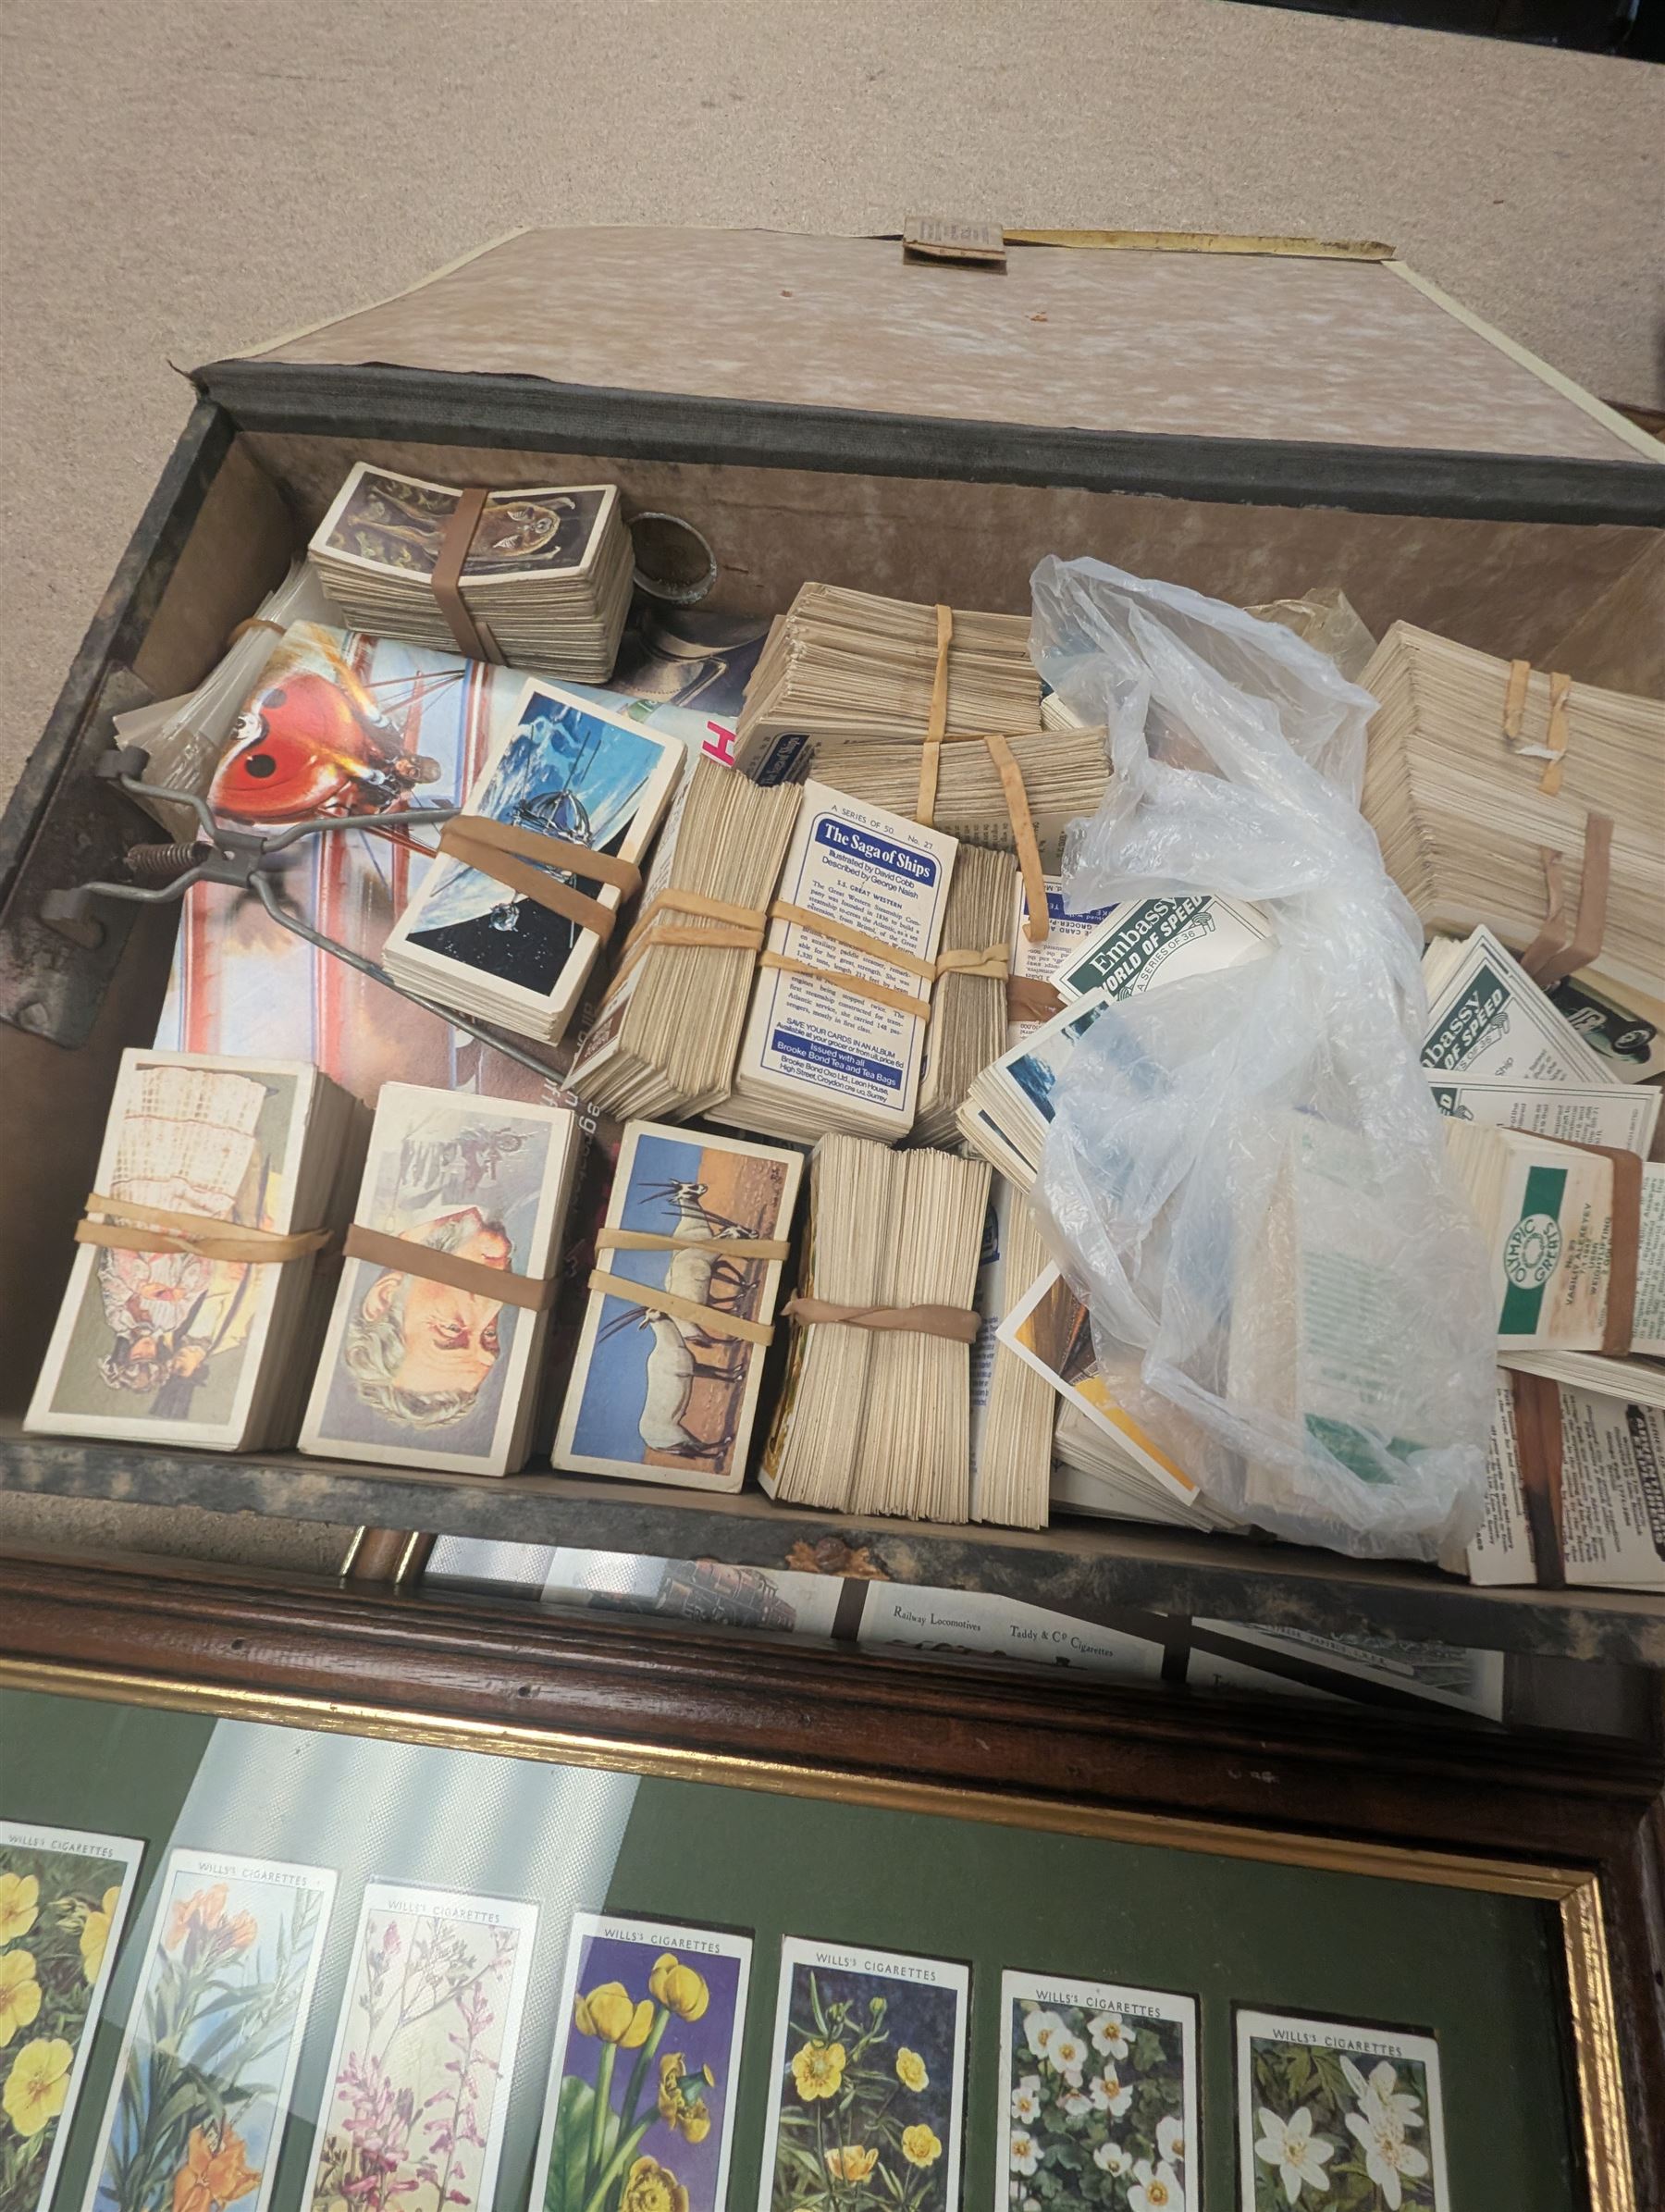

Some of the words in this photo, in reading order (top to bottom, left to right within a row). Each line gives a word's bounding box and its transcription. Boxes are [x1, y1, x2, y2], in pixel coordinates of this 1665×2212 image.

[842, 807, 867, 824] SERIES
[870, 819, 882, 829] OF
[884, 825, 894, 834] 50
[907, 834, 921, 845] No.
[924, 841, 933, 850] 27
[823, 822, 850, 846] The
[849, 833, 882, 862] Saga
[882, 846, 897, 865] of
[895, 851, 931, 881] Ships
[828, 848, 862, 868] Illustrated
[863, 862, 873, 873] by
[874, 867, 894, 881] David
[894, 875, 914, 889] Cobb
[821, 856, 860, 877] Described
[861, 871, 870, 882] by
[870, 875, 897, 893] George
[897, 886, 918, 899] Naish
[849, 884, 870, 896] GREAT
[872, 893, 902, 909] WESTERN
[812, 880, 824, 889] The
[828, 885, 844, 896] Great
[847, 894, 871, 907] Western
[873, 904, 902, 921] Steamship
[841, 899, 864, 912] founded
[1088, 896, 1178, 977] Embassy
[1141, 935, 1160, 956] OF
[1160, 896, 1203, 938] SPEED
[1141, 947, 1168, 981] SERIES
[1167, 935, 1181, 950] OF
[1182, 930, 1195, 941] 36
[786, 1017, 805, 1028] SAVE
[805, 1023, 826, 1035] YOUR
[826, 1030, 851, 1044] CARDS
[860, 1041, 871, 1050] AN
[871, 1044, 894, 1058] ALBUM
[1422, 990, 1483, 1069] bassy
[1444, 1045, 1462, 1070] OF
[1464, 988, 1503, 1047] SPEED
[776, 1041, 807, 1057] Brooke
[808, 1051, 829, 1064] Bond
[830, 1058, 845, 1069] Tea
[845, 1063, 860, 1074] and
[861, 1068, 875, 1079] Tea
[876, 1072, 895, 1087] Bags
[780, 1055, 804, 1068] Brooke
[805, 1063, 822, 1074] Bond
[810, 1043, 837, 1057] Issued
[837, 1052, 855, 1063] with
[856, 1057, 865, 1066] all
[1507, 1218, 1536, 1283] OLYMPIC
[1535, 1222, 1558, 1282] GREATS
[893, 1605, 926, 1626] Railway
[930, 1613, 980, 1632] Locomotives
[1009, 1625, 1038, 1641] Taddy
[1041, 1630, 1048, 1639] &
[1070, 1636, 1114, 1657] Cigarettes
[433, 1906, 500, 1923] CIGARETTES
[650, 1934, 721, 1954] CIGARETTES
[864, 1960, 936, 1982] CIGARETTES
[1086, 1996, 1161, 2018] CIGARETTES
[1324, 2035, 1403, 2057] CIGARETTES
